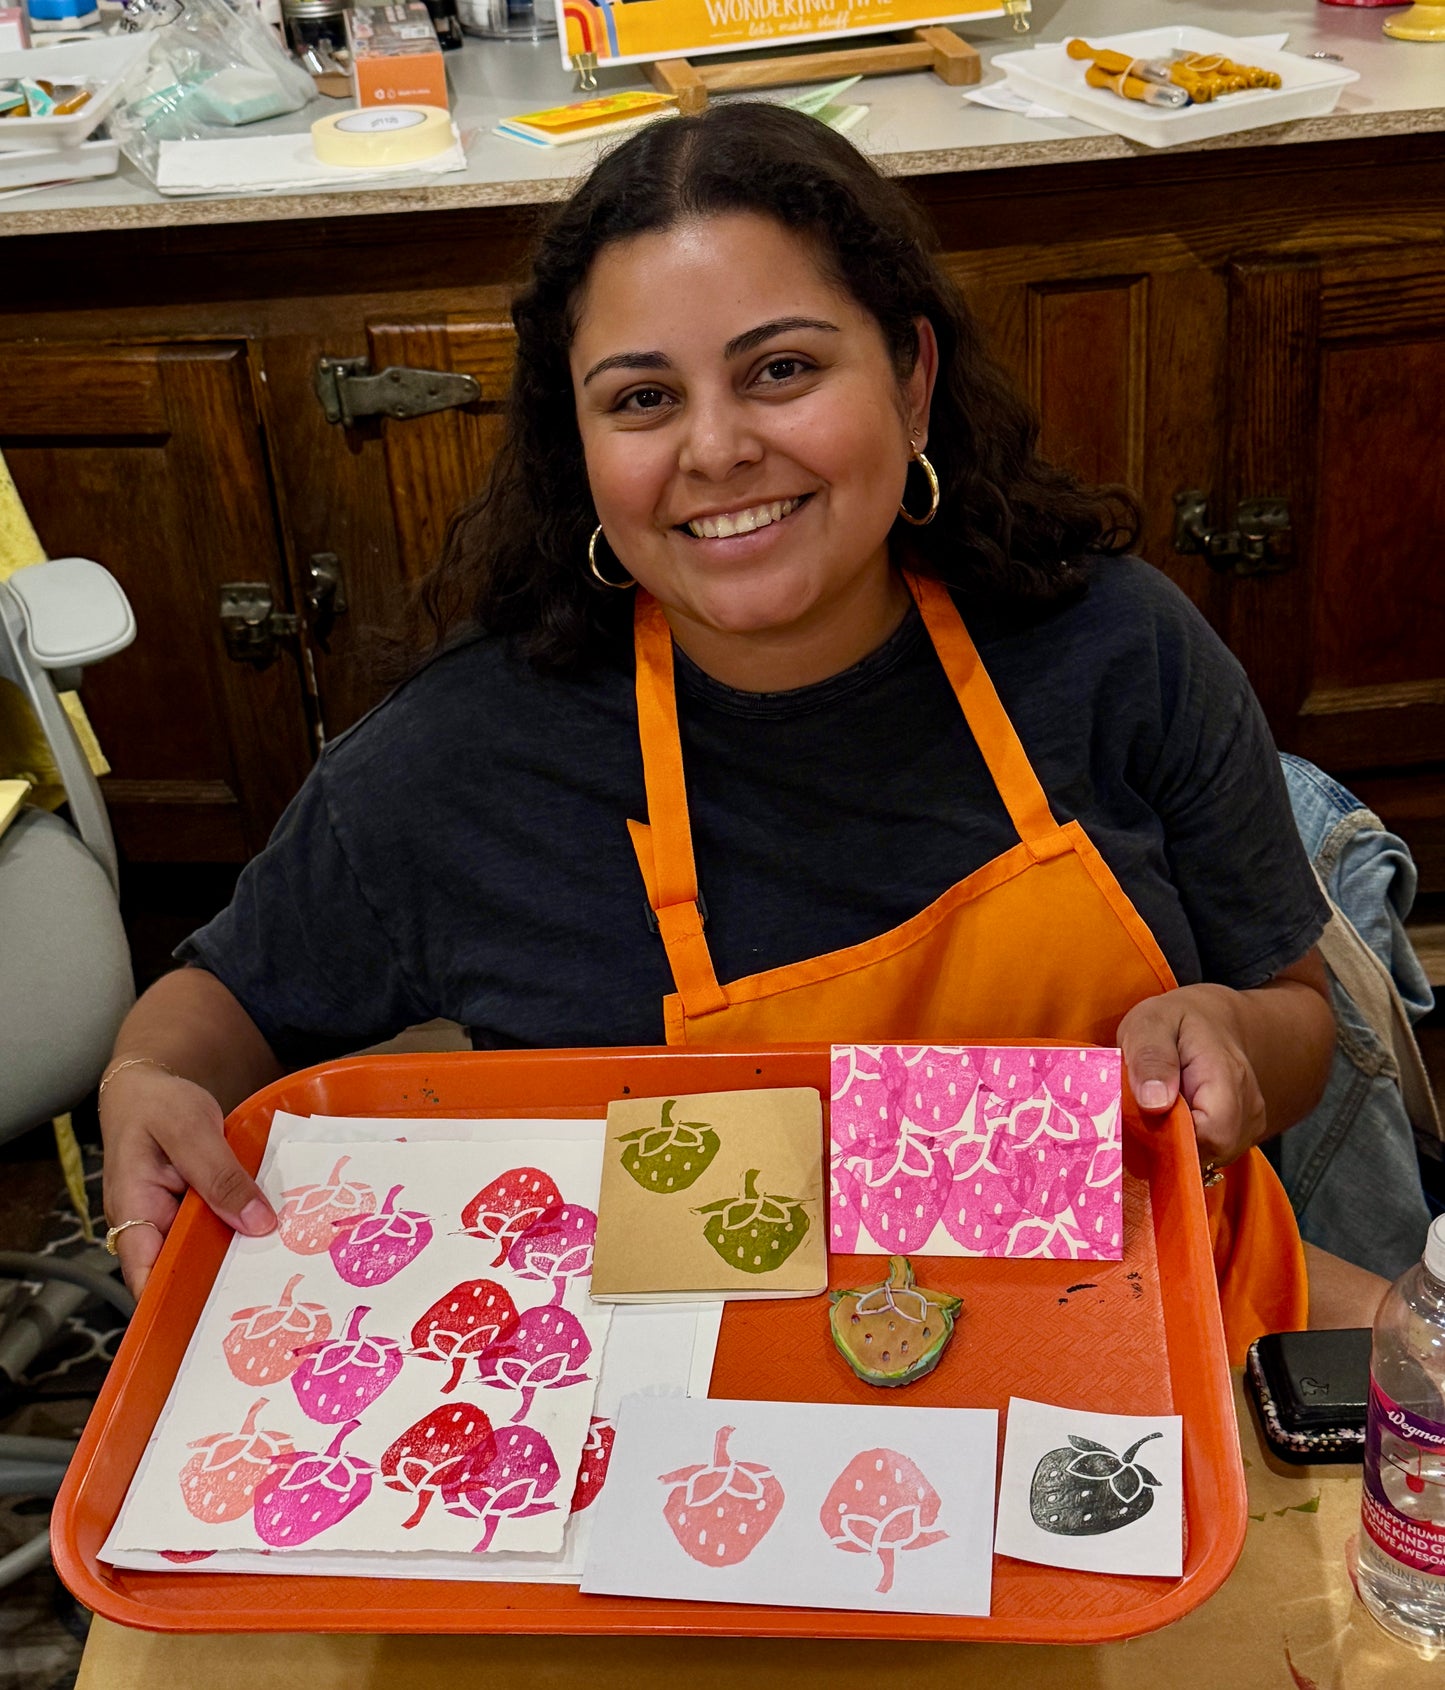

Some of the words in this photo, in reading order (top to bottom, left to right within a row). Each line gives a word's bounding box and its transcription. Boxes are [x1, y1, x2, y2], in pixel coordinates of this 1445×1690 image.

[817, 10, 850, 31] stuff
[1374, 1500, 1406, 1529] HAPPY
[1368, 1517, 1397, 1547] ACTIVE
[1391, 1526, 1428, 1550] KIND
